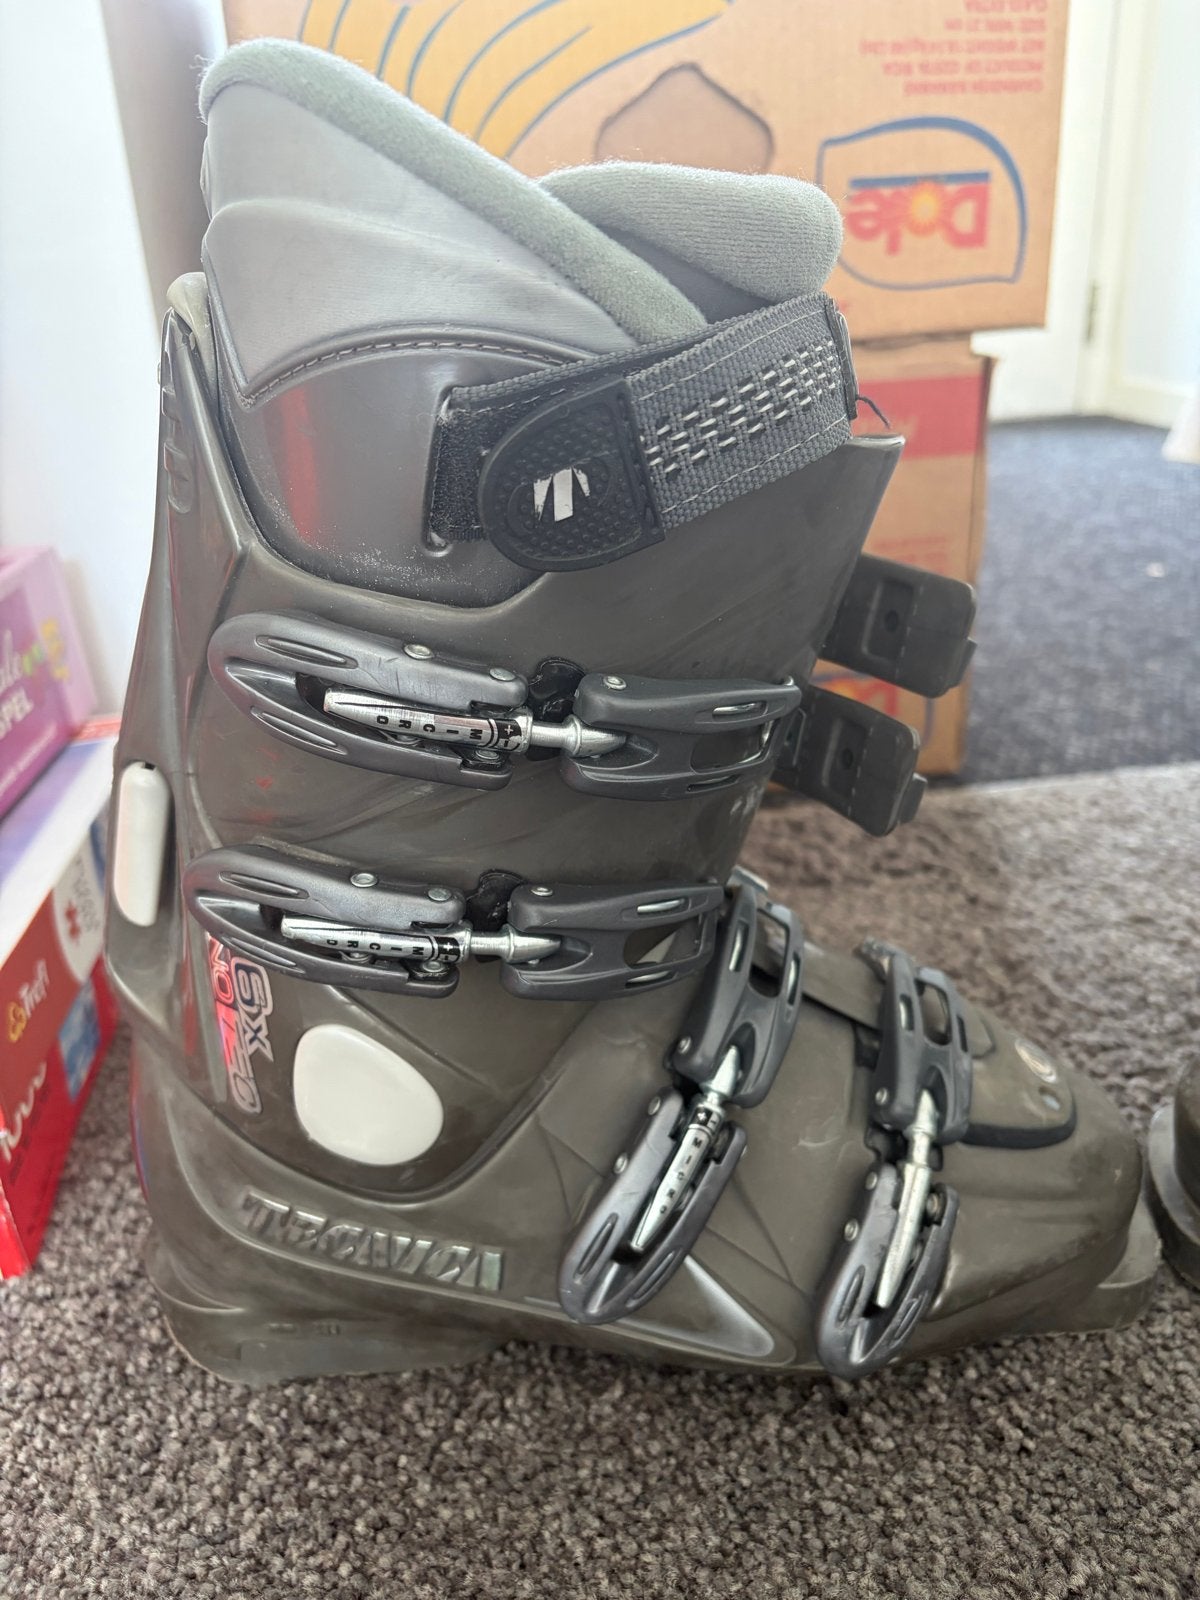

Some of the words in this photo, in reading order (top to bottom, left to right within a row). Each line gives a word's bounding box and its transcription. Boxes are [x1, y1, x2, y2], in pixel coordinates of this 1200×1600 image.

[844, 181, 989, 256] Dole
[376, 715, 483, 741] MICRO
[326, 938, 425, 957] MICRO
[659, 1136, 703, 1215] MICRO
[242, 1191, 502, 1291] TECNICA
